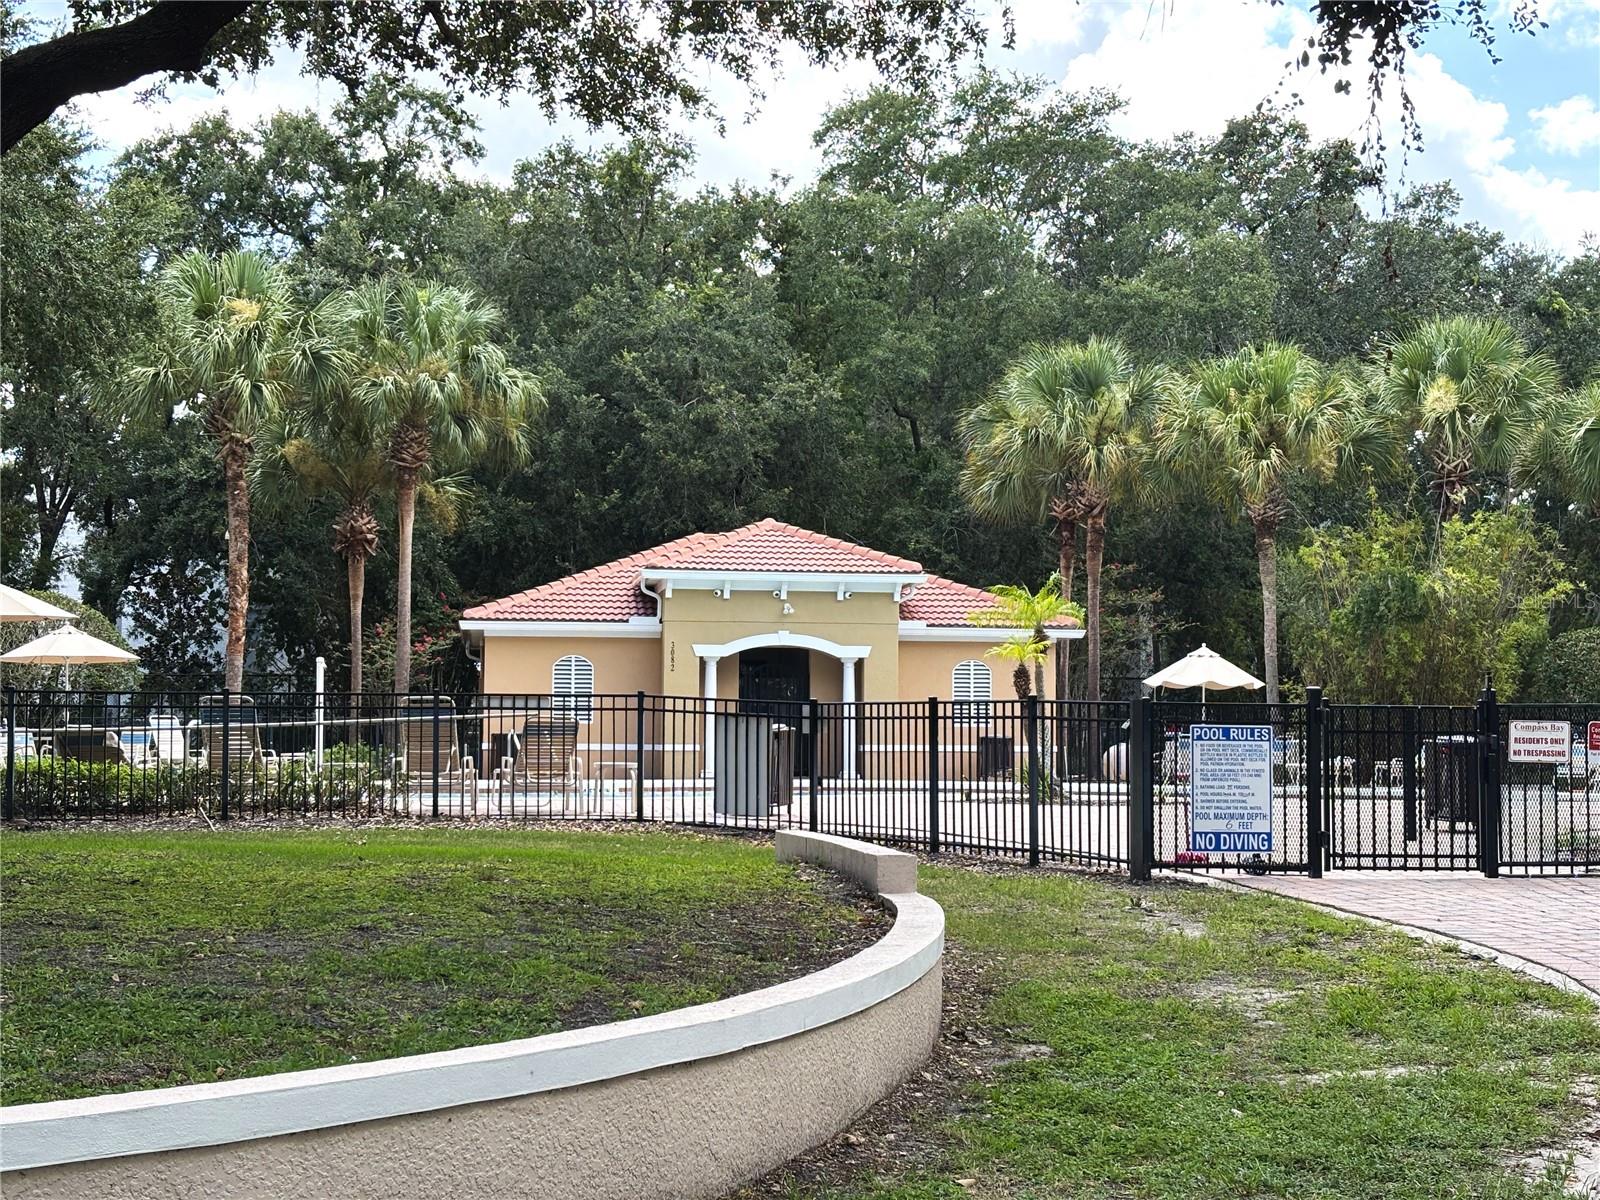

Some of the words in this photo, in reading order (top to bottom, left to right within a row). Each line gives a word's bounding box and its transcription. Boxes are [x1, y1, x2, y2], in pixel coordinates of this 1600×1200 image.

[1515, 723, 1548, 732] Compass
[1551, 723, 1564, 732] Bay
[1193, 728, 1226, 740] POOL
[1230, 728, 1269, 740] RULES
[1514, 737, 1548, 745] RESIDENTS
[1550, 737, 1565, 745] ONLY
[1247, 813, 1269, 821] DEPTH:
[1226, 820, 1233, 830] 6
[1239, 822, 1253, 830] FEET
[1196, 834, 1215, 850] NO
[1220, 834, 1268, 850] DIVING
